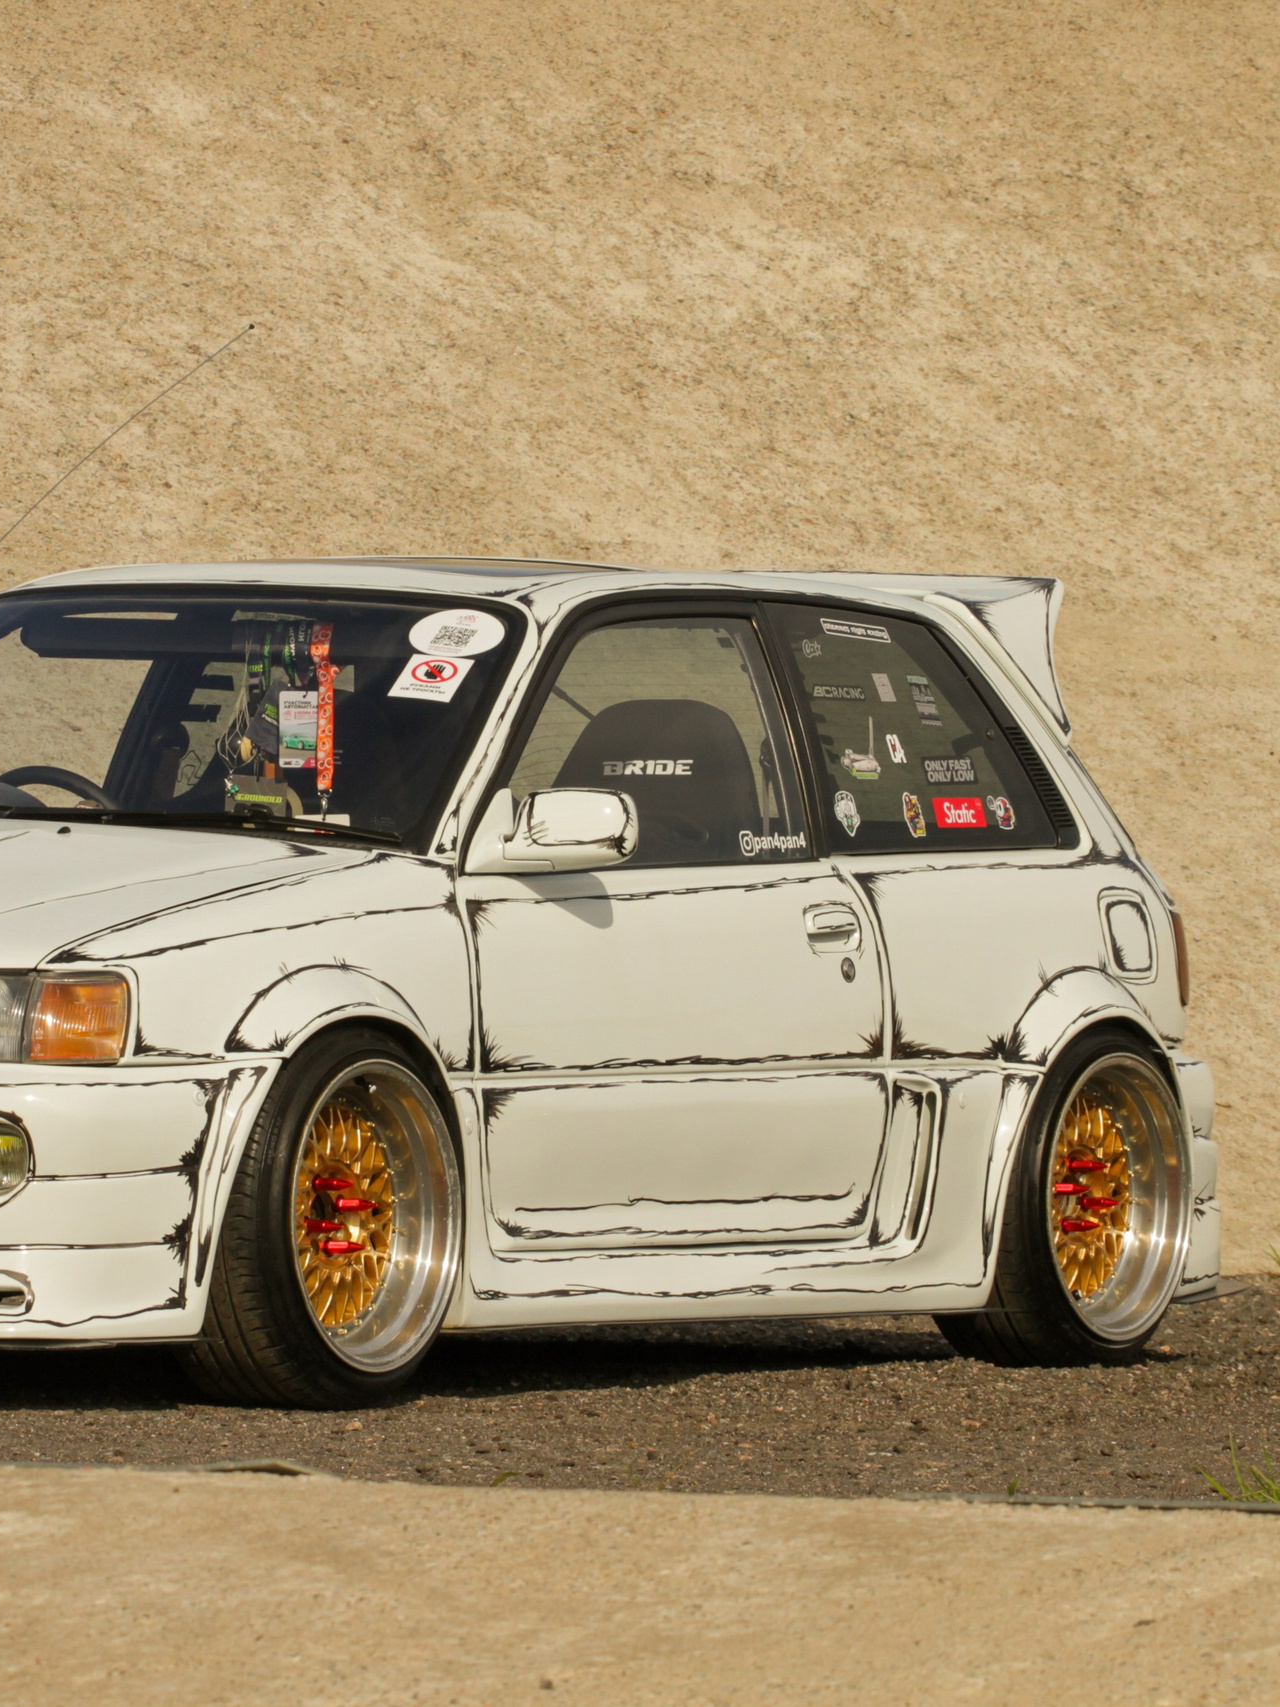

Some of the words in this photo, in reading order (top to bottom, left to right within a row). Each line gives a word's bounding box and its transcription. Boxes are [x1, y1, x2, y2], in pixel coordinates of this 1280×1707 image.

[832, 686, 865, 699] RACING
[603, 759, 693, 775] BRIDE
[924, 759, 949, 771] ONLY
[949, 759, 971, 770] FAST
[927, 771, 954, 782] ONLY
[953, 770, 974, 782] LOW
[943, 802, 977, 824] Static
[754, 832, 806, 852] pan4pan4
